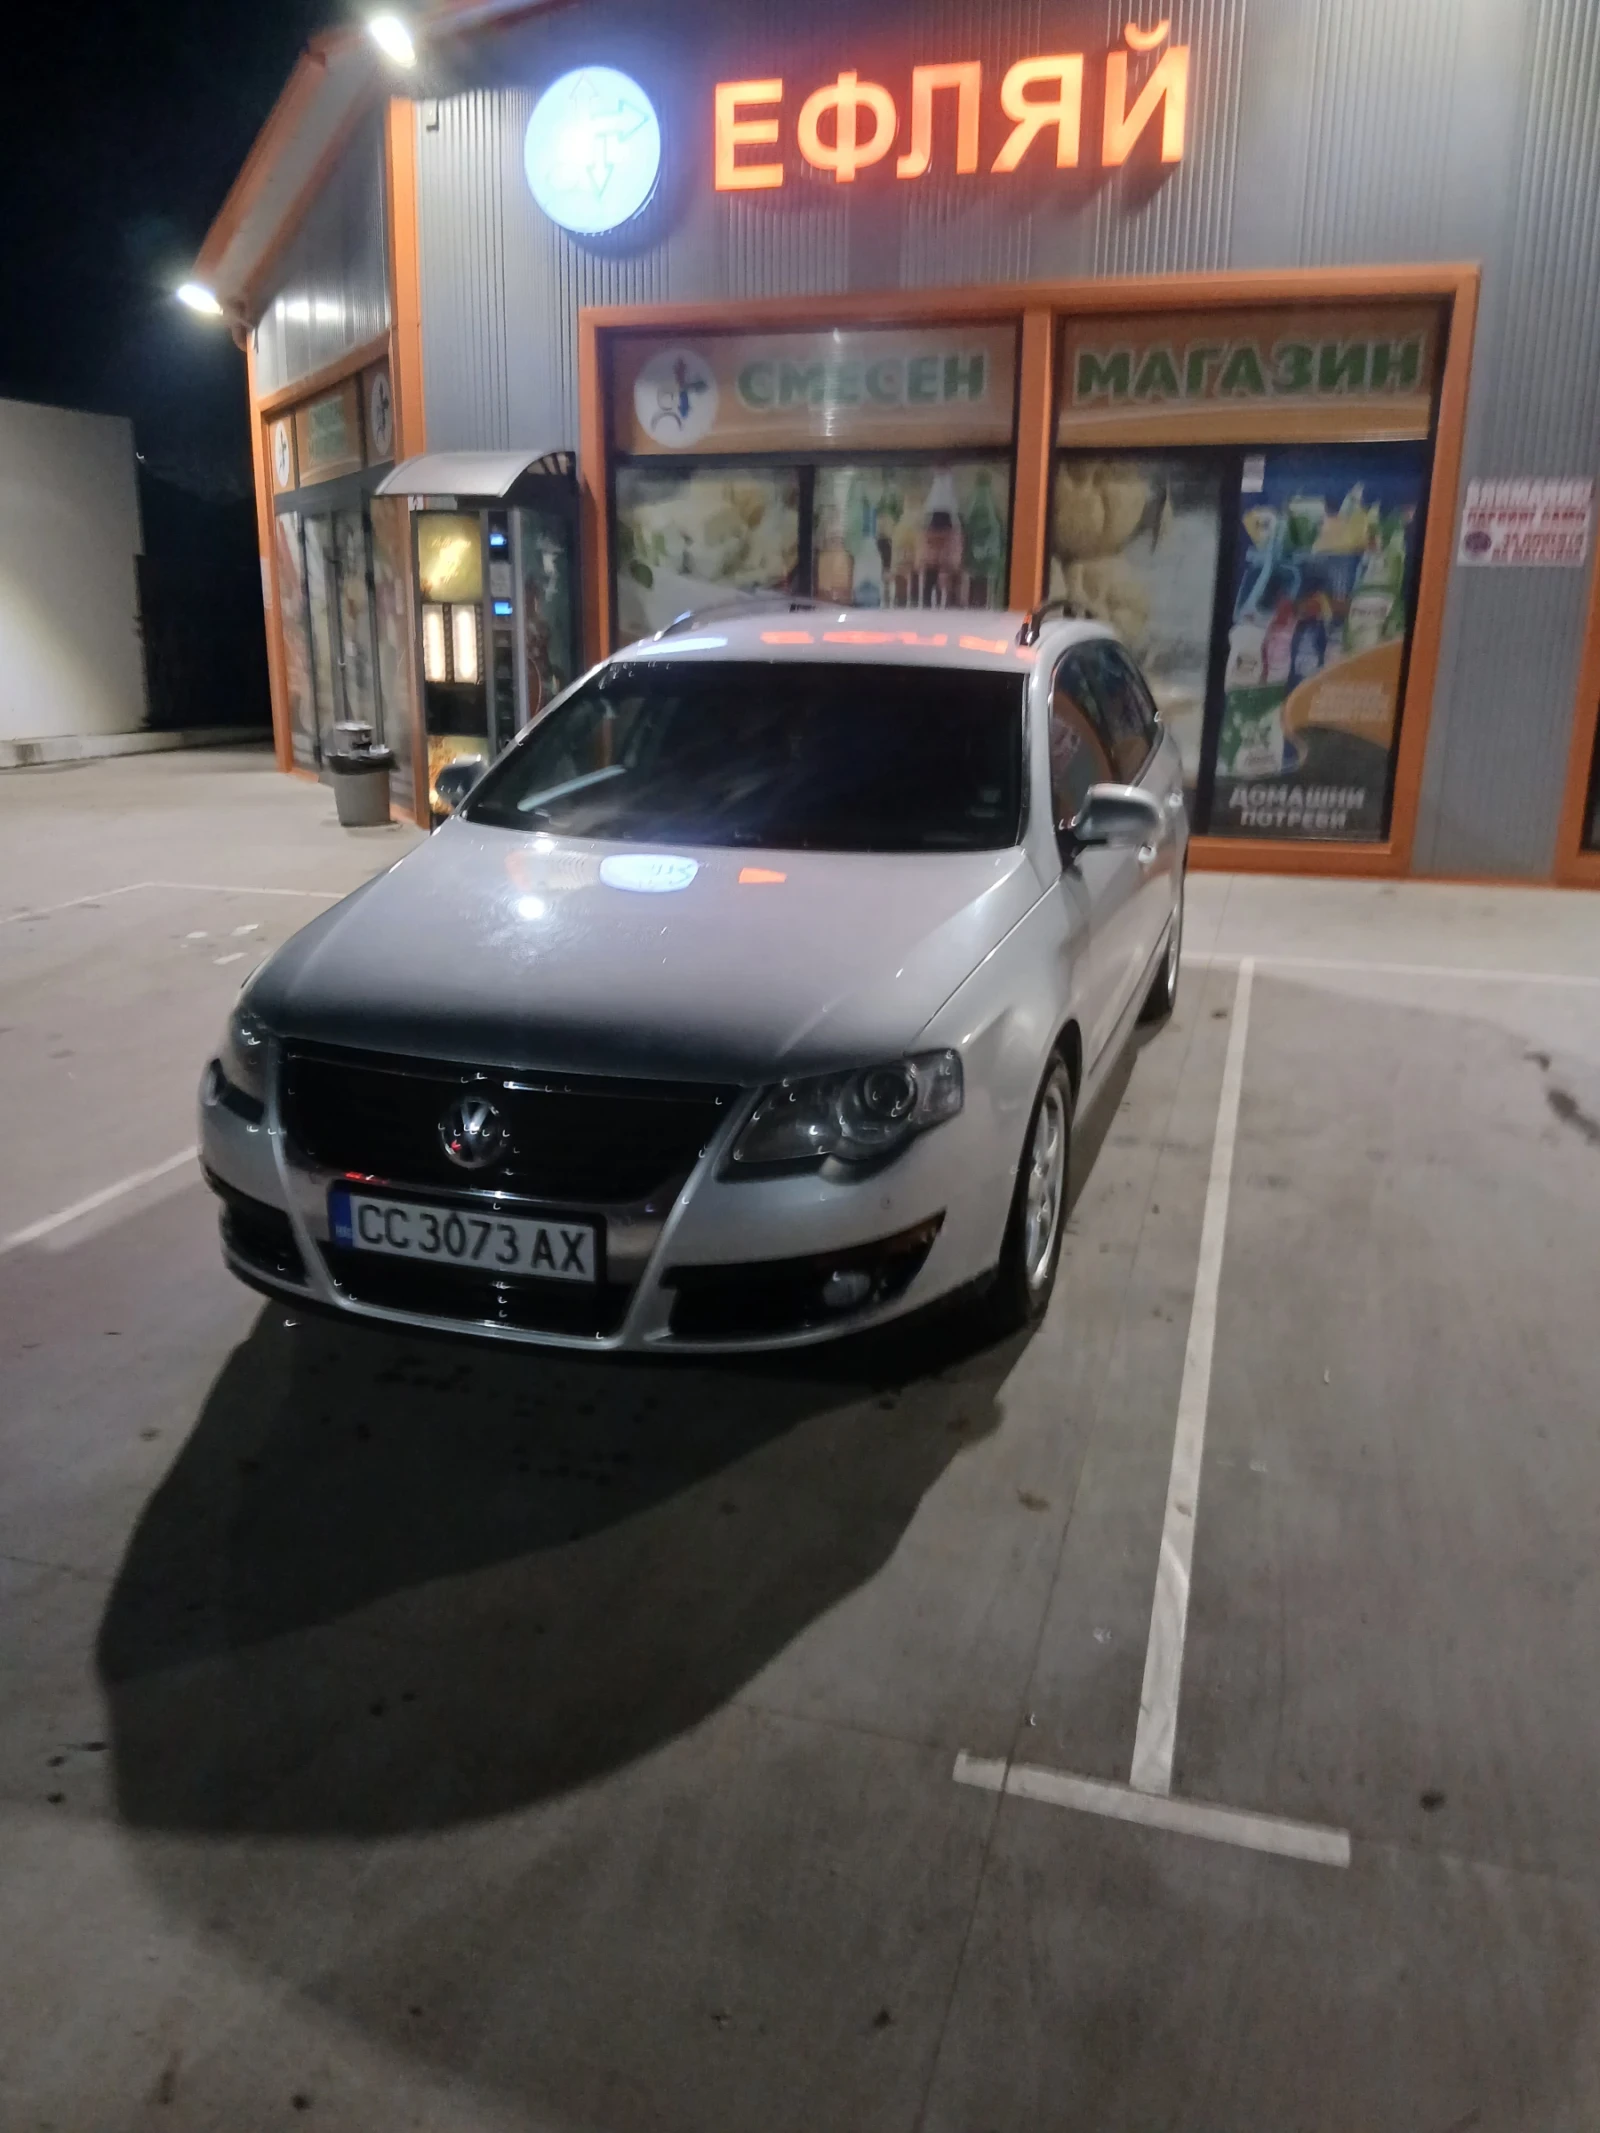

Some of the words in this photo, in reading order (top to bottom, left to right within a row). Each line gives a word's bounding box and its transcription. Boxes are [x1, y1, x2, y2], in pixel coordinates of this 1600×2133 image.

[714, 19, 1190, 191] ЕФЛЯЙ
[737, 353, 987, 409] СМЕСЕН
[1074, 335, 1427, 402] МАГАЗИН
[1229, 784, 1367, 809] ДОМАШНИ
